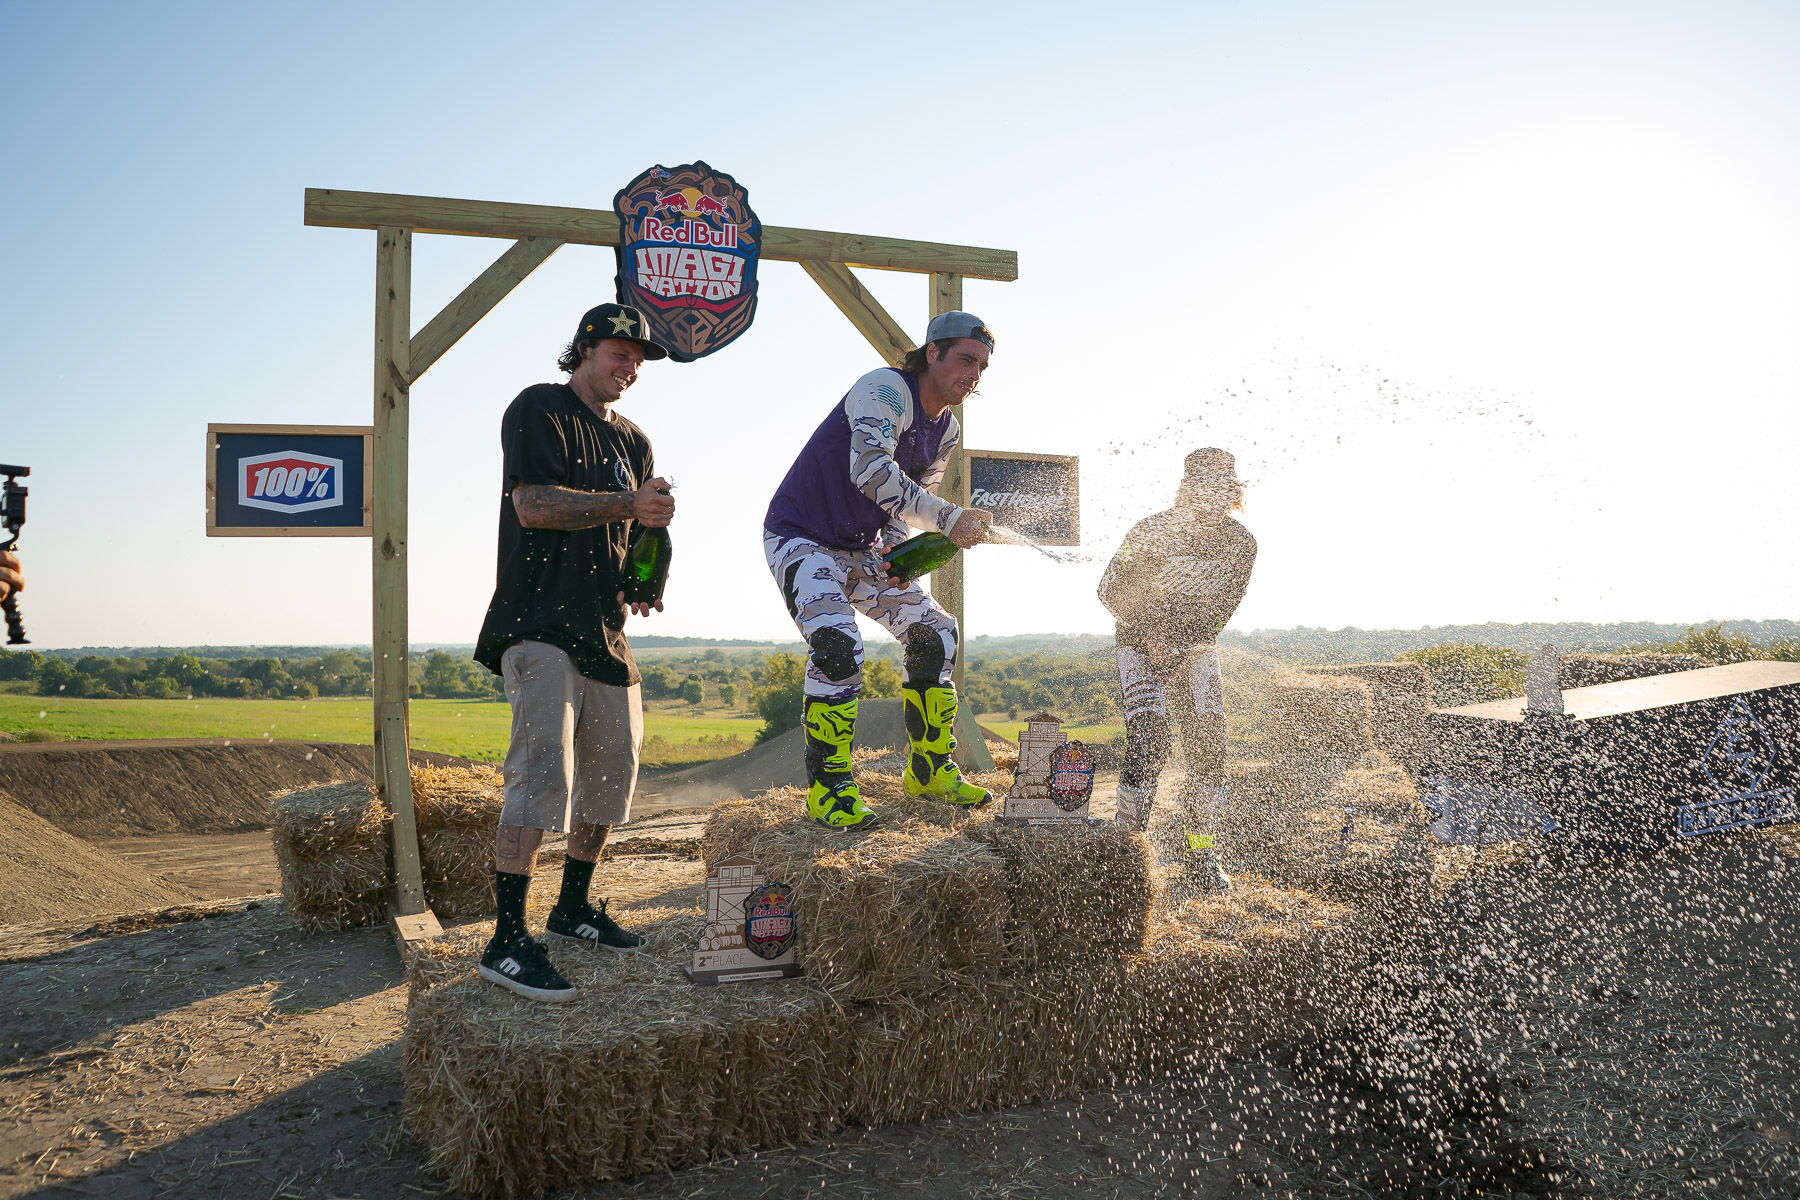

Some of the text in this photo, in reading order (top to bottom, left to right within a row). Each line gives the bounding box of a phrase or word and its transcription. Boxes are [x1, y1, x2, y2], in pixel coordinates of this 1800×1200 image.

[645, 218, 736, 247] Red Bull
[635, 247, 746, 282] IMAGI
[638, 273, 741, 301] NATION
[253, 466, 330, 498] 100%
[754, 905, 791, 917] Red Bull
[712, 952, 746, 967] PLACE
